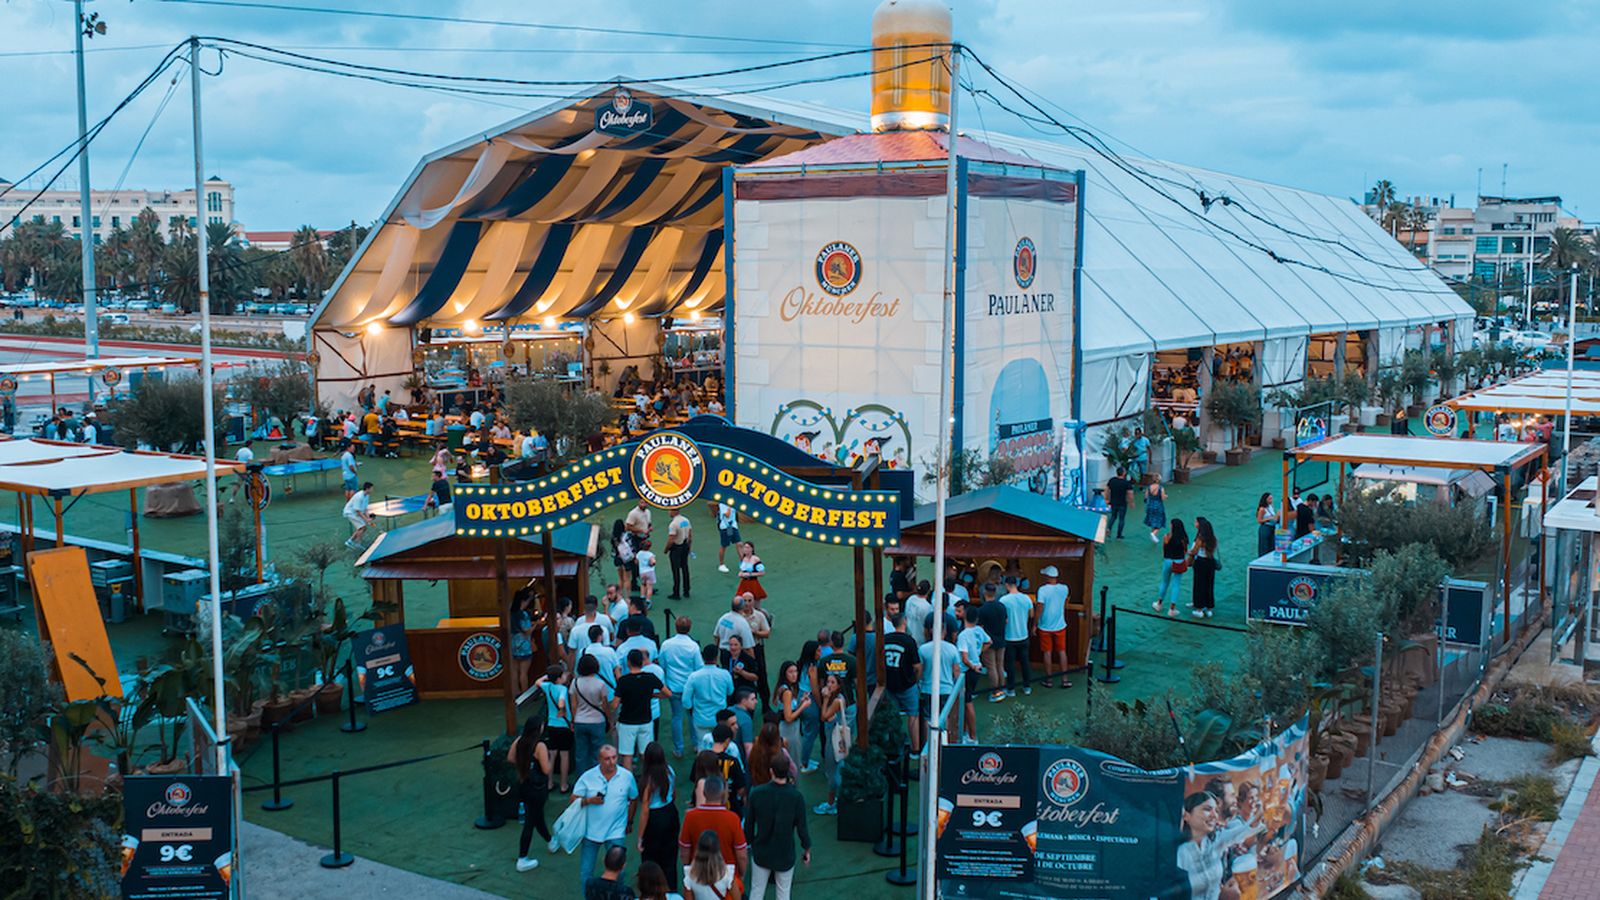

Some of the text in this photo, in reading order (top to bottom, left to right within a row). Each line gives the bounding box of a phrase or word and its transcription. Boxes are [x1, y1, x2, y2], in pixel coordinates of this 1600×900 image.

[818, 243, 860, 263] PAULANER
[780, 286, 900, 324] Oktoberfest
[988, 294, 1055, 315] PAULANER
[637, 436, 701, 467] PAULANER
[466, 467, 622, 520] OKTOBERFEST
[718, 469, 886, 529] OKTOBERFEST
[885, 651, 901, 667] 27
[376, 665, 394, 678] 9€
[961, 769, 1018, 785] Oktoberfest
[147, 802, 208, 818] Oktoberfest
[973, 810, 1003, 827] 9€
[160, 845, 193, 862] 9€
[1046, 853, 1096, 862] SEPTIEMBRE
[1055, 862, 1094, 871] OCTUBRE
